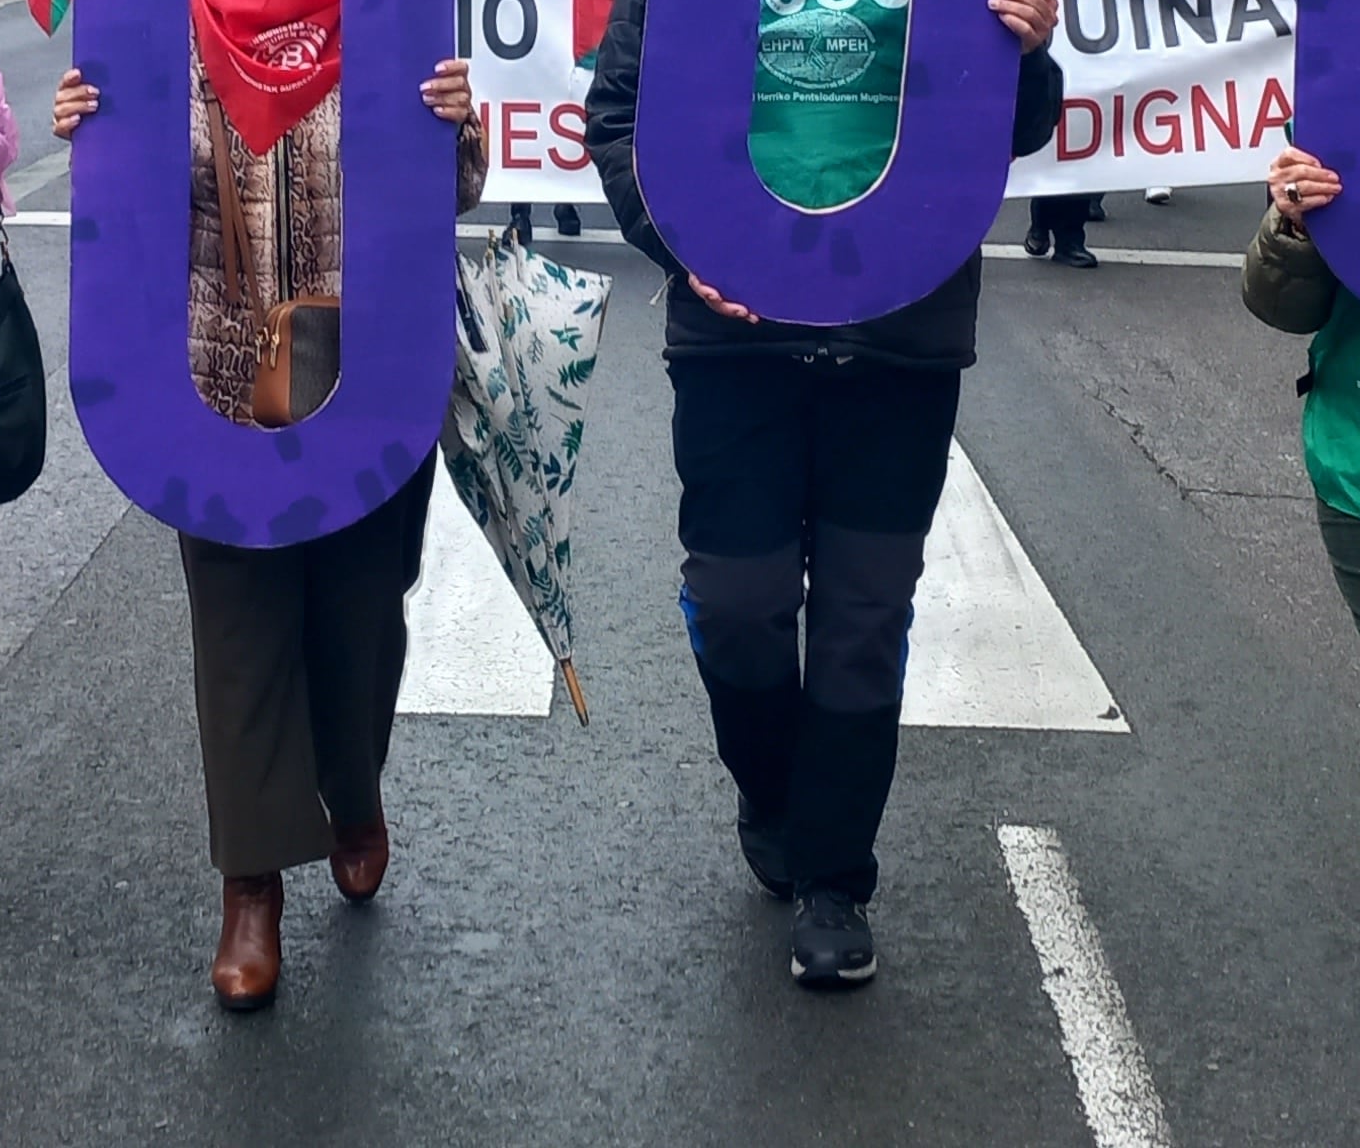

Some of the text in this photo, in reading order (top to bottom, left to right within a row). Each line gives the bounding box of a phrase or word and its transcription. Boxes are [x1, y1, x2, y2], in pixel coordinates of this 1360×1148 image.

[761, 38, 869, 52] EHPM MPEH
[757, 92, 791, 102] Herriko
[481, 102, 593, 171] ES
